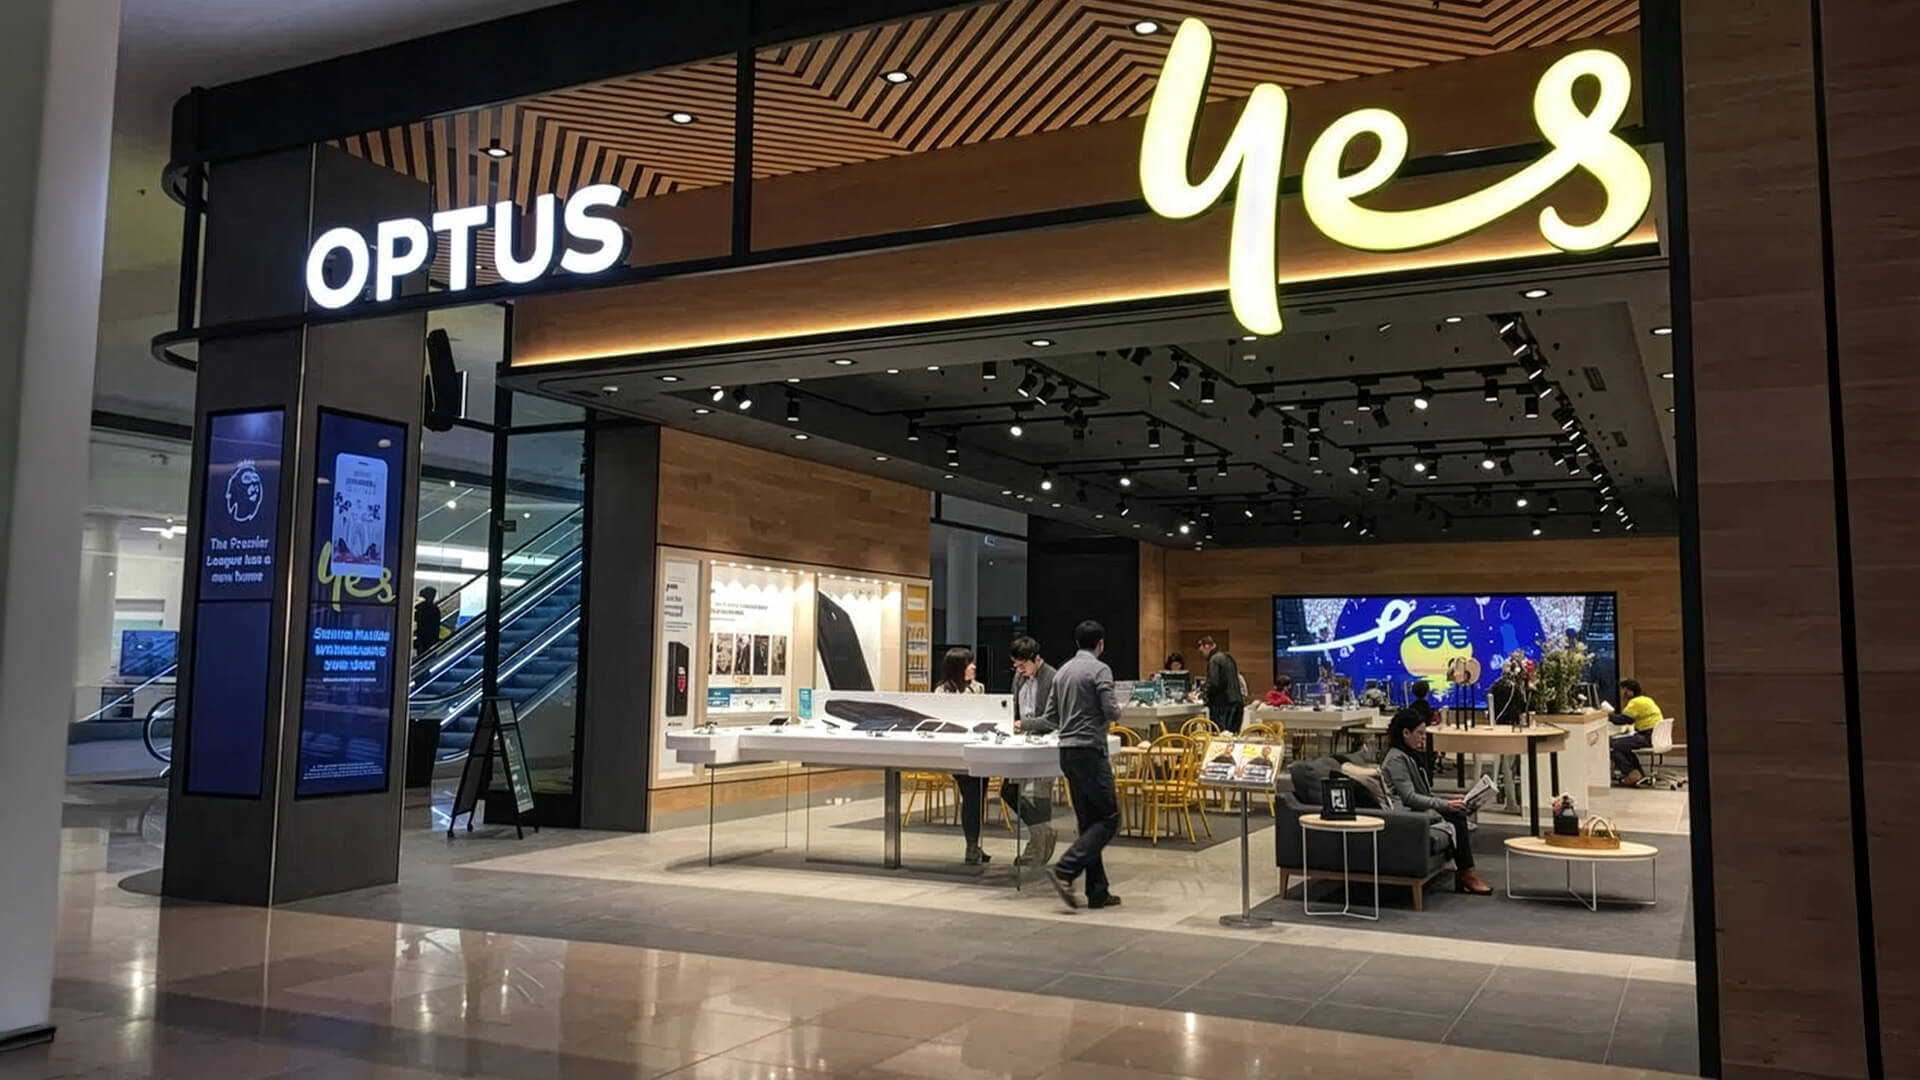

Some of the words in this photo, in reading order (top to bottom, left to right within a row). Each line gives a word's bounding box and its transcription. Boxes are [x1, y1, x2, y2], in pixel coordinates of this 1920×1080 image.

[1140, 17, 1652, 336] yes
[306, 184, 625, 309] OPTUS
[210, 537, 228, 550] The
